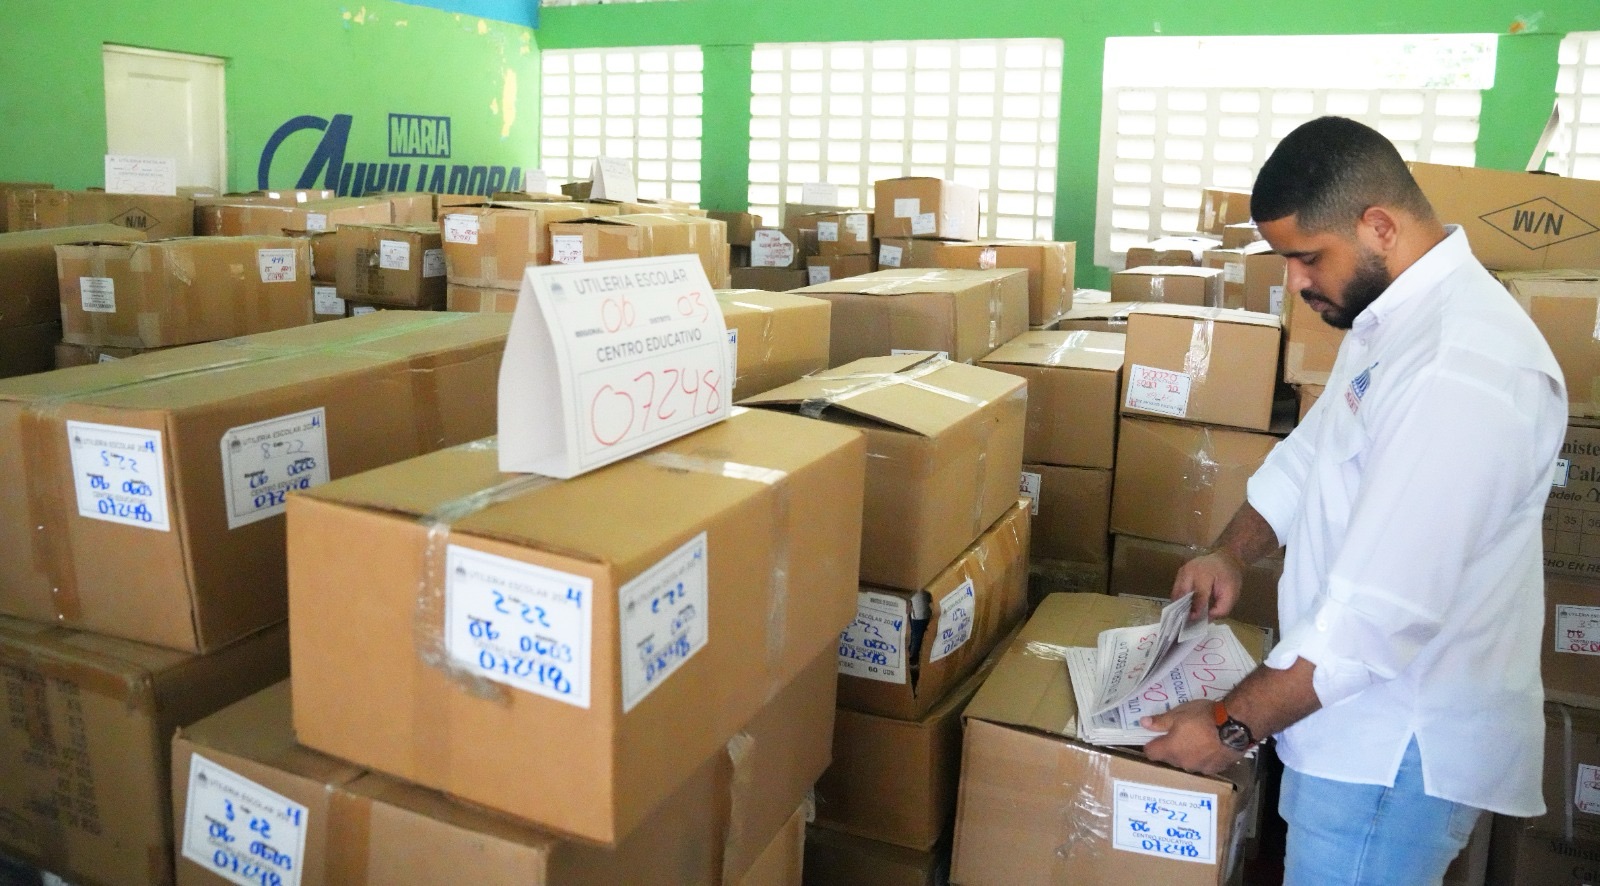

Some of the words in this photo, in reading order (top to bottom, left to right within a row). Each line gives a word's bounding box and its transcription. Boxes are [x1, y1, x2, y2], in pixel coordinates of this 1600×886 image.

[391, 117, 449, 155] MARIA
[125, 216, 147, 229] N/M
[574, 274, 634, 295] UTILERIA
[637, 269, 687, 288] ESCOLAR
[677, 292, 708, 323] 03
[596, 339, 643, 363] CENTRO
[646, 328, 702, 352] EDUCATIVO
[591, 368, 720, 446] 07248
[244, 434, 271, 446] UTILERIA
[273, 427, 301, 439] ESCOLAR
[261, 442, 271, 459] 8
[286, 439, 310, 454] 22
[1561, 439, 1600, 457] niste
[1563, 515, 1577, 525] 35
[1568, 561, 1585, 570] EN
[492, 590, 510, 614] 2
[520, 603, 551, 628] 22
[859, 613, 882, 622] ESCOLAR
[469, 620, 500, 640] 06
[520, 636, 573, 663] 0603
[480, 649, 572, 694] 07248
[1185, 637, 1242, 700] 7968
[1173, 681, 1190, 704] ENTRO
[1128, 696, 1141, 714] UTIL
[1129, 794, 1157, 803] UTILERIA
[1159, 798, 1187, 807] ESCOLAR
[1168, 810, 1189, 822] 22
[1133, 832, 1157, 841] CENTRO
[1167, 828, 1201, 840] 0603
[1142, 839, 1199, 857] 07248
